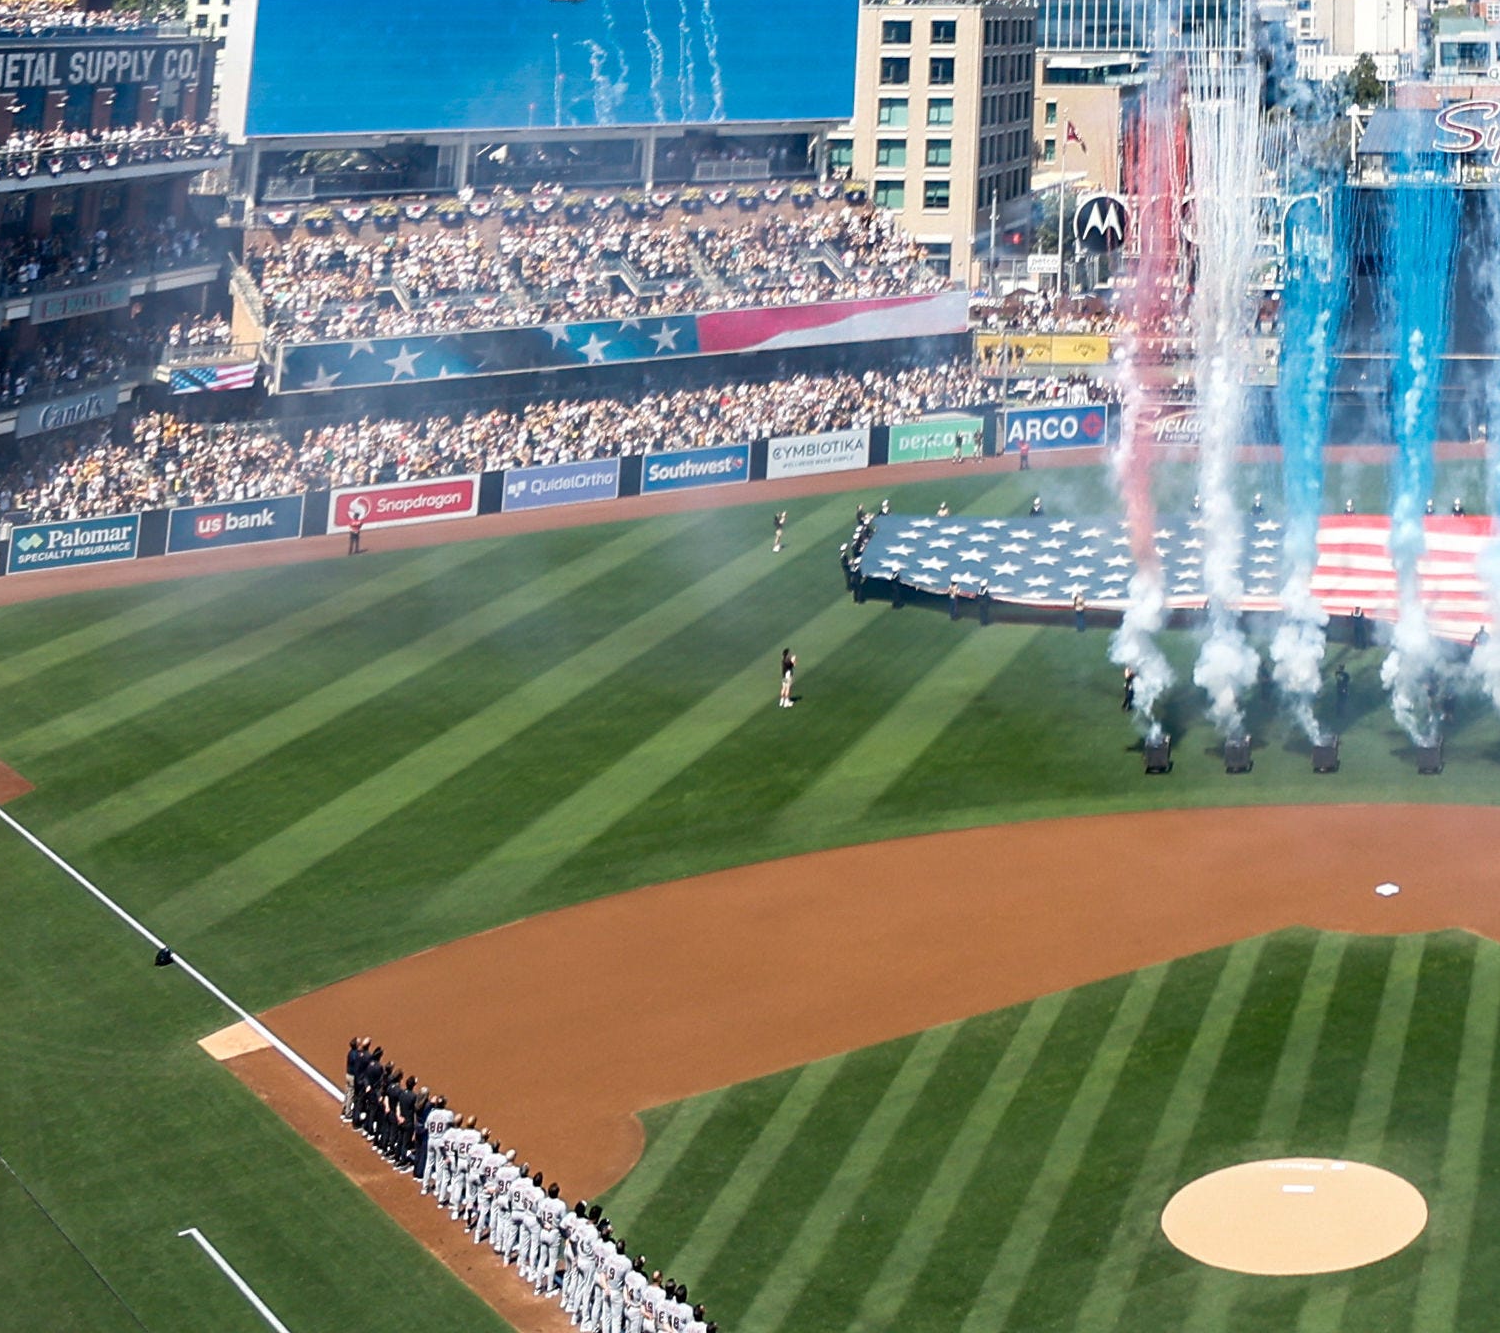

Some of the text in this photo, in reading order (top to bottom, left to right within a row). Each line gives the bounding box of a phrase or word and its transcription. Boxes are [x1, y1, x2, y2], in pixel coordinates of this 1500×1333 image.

[69, 47, 156, 84] SUPPLY
[163, 46, 199, 80] CO.
[40, 393, 102, 430] Canel's
[1007, 416, 1079, 442] ARCO
[772, 437, 865, 460] CYMBIOTIKA
[648, 456, 734, 482] Southwest
[531, 473, 613, 496] QuidelOrtho
[376, 490, 463, 515] Snapdragon
[198, 507, 275, 534] us bank
[47, 525, 132, 550] Palomar
[17, 541, 132, 564] SPECIALTY INSURANCE
